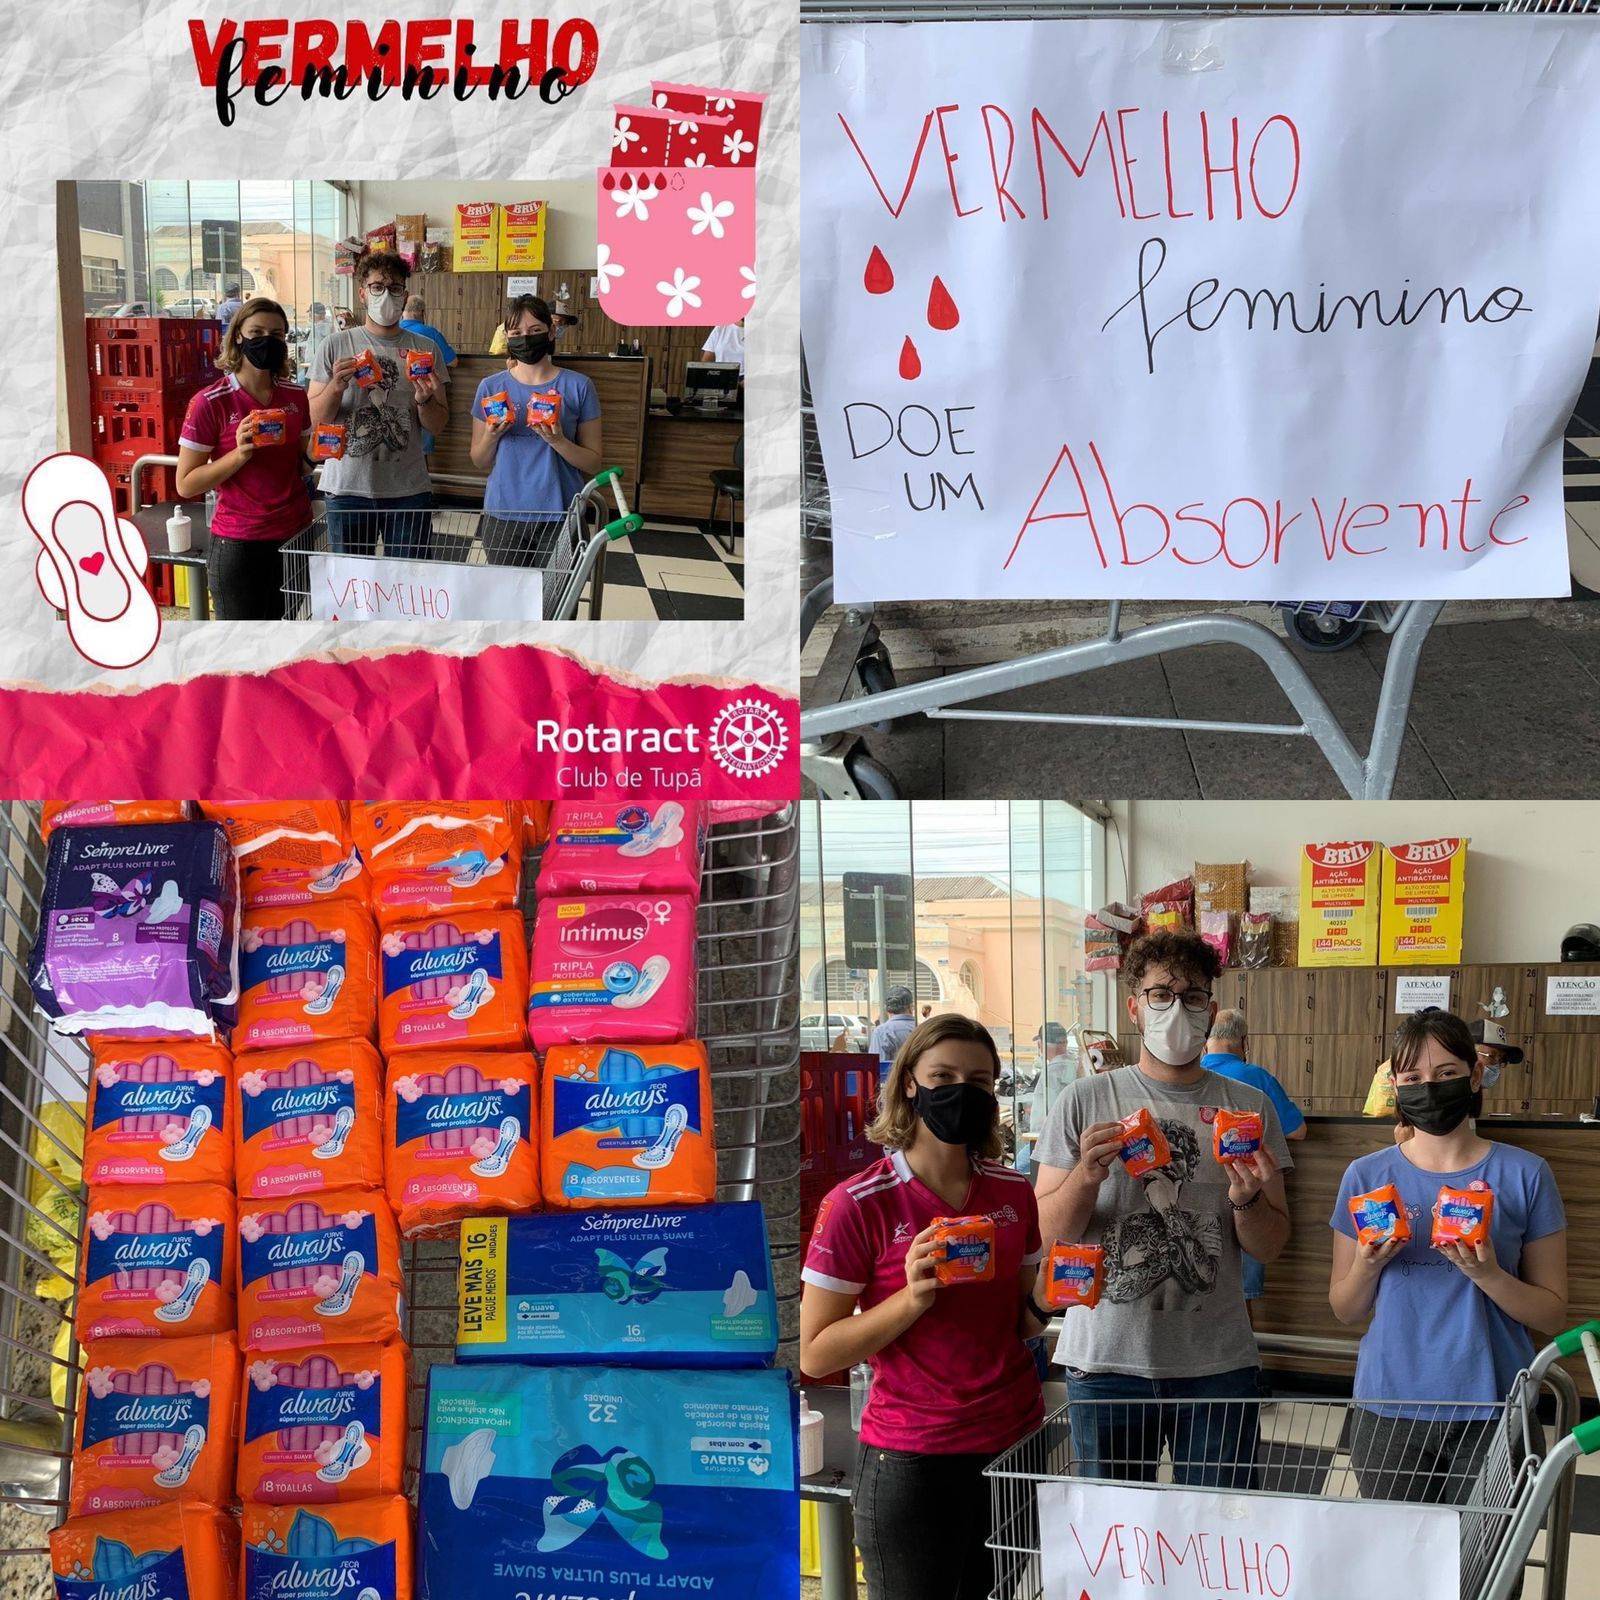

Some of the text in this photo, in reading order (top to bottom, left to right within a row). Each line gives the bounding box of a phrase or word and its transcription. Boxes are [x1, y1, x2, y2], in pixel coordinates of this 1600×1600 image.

[838, 104, 1301, 222] VERMELHO
[1101, 238, 1532, 375] feminino
[844, 402, 975, 460] DOE
[903, 471, 985, 512] UM
[1004, 441, 1531, 570] Absorvente
[327, 577, 450, 619] VERMELHO
[63, 805, 114, 820] ABSORVENTES
[566, 812, 603, 820] TRIPLA
[80, 842, 173, 859] SempreLivre
[1322, 844, 1370, 864] BRIL
[1405, 840, 1455, 864] BRIL
[1314, 877, 1363, 885] ANTIBACTÉRIA
[1397, 874, 1448, 882] ANTIBACTÉRIA
[392, 884, 452, 894] 8 ABSORVENTES
[264, 892, 313, 902] ABSORVENTES
[112, 933, 119, 942] 8
[560, 923, 645, 942] Intimus
[1317, 938, 1362, 947] 144 PACKS
[267, 950, 330, 969] always
[410, 950, 475, 973] always
[553, 961, 593, 971] TRIPLA
[552, 970, 594, 979] PROTEÇÃO
[1307, 973, 1315, 981] 11
[1527, 969, 1536, 978] 26
[1405, 980, 1442, 988] ATENÇÃO
[1556, 980, 1596, 989] ATENÇÃO
[261, 1024, 311, 1037] ABSORVENTES
[403, 1022, 445, 1033] 8 TOALLAS
[1524, 1036, 1533, 1044] 27
[121, 1085, 194, 1111] always
[272, 1090, 338, 1112] always
[585, 1087, 667, 1113] always
[426, 1098, 501, 1123] always
[1521, 1102, 1530, 1110] 28
[101, 1166, 164, 1175] 8 ABSORVENTES
[261, 1171, 321, 1186] 8 ABSORVENTES
[570, 1175, 640, 1184] 8 ABSORVENTES
[412, 1184, 477, 1193] 8 ABSORVENTES
[580, 1213, 686, 1232] SempreLivre
[489, 1224, 498, 1259] UNIDADES
[570, 1231, 694, 1243] ADAPT PLUS ULTRA SUAVE
[115, 1236, 191, 1264] always
[268, 1236, 345, 1260] always
[959, 1243, 984, 1254] always
[1065, 1270, 1089, 1278] always
[463, 1233, 487, 1332] LEVE MAIS 16
[485, 1296, 496, 1321] PAGUE
[255, 1324, 321, 1338] 8 ABSORVENTES
[626, 1325, 640, 1335] 16
[583, 1394, 623, 1403] UNIDADES
[279, 1391, 354, 1421] always
[738, 1404, 770, 1412] Formato
[116, 1398, 190, 1428] always
[588, 1404, 618, 1423] 32
[684, 1411, 725, 1421] proteção
[436, 1416, 511, 1427] HIPOALERGÊNICO
[695, 1420, 770, 1430] Rápida absorção
[699, 1455, 745, 1467] suave
[265, 1481, 312, 1492] 8 TOALLAS
[92, 1497, 100, 1508] 8
[1069, 1522, 1290, 1597] VERMELHO
[272, 1561, 358, 1597] always
[493, 1563, 714, 1591] ADAPT PLUS ULTRA SUAVE
[88, 1580, 157, 1600] always
[278, 1590, 329, 1600] super proteção
